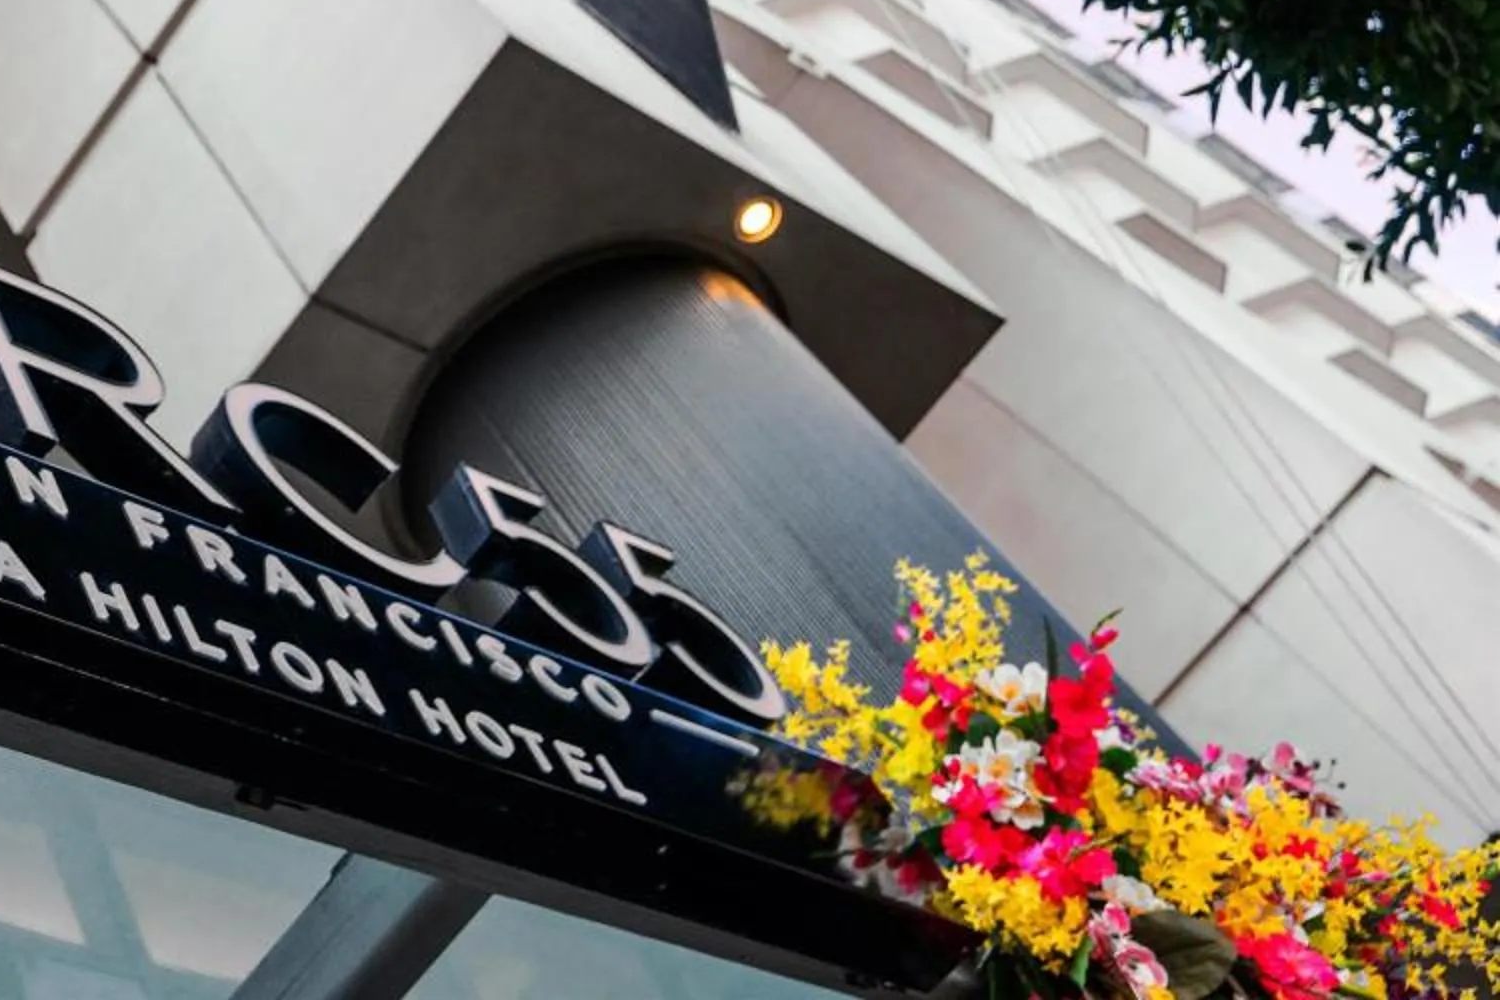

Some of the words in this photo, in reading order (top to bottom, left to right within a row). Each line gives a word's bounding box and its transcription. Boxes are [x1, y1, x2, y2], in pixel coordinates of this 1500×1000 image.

[78, 570, 386, 716] HILTON
[409, 688, 648, 805] HOTEL
[122, 499, 633, 722] FRANCISCO
